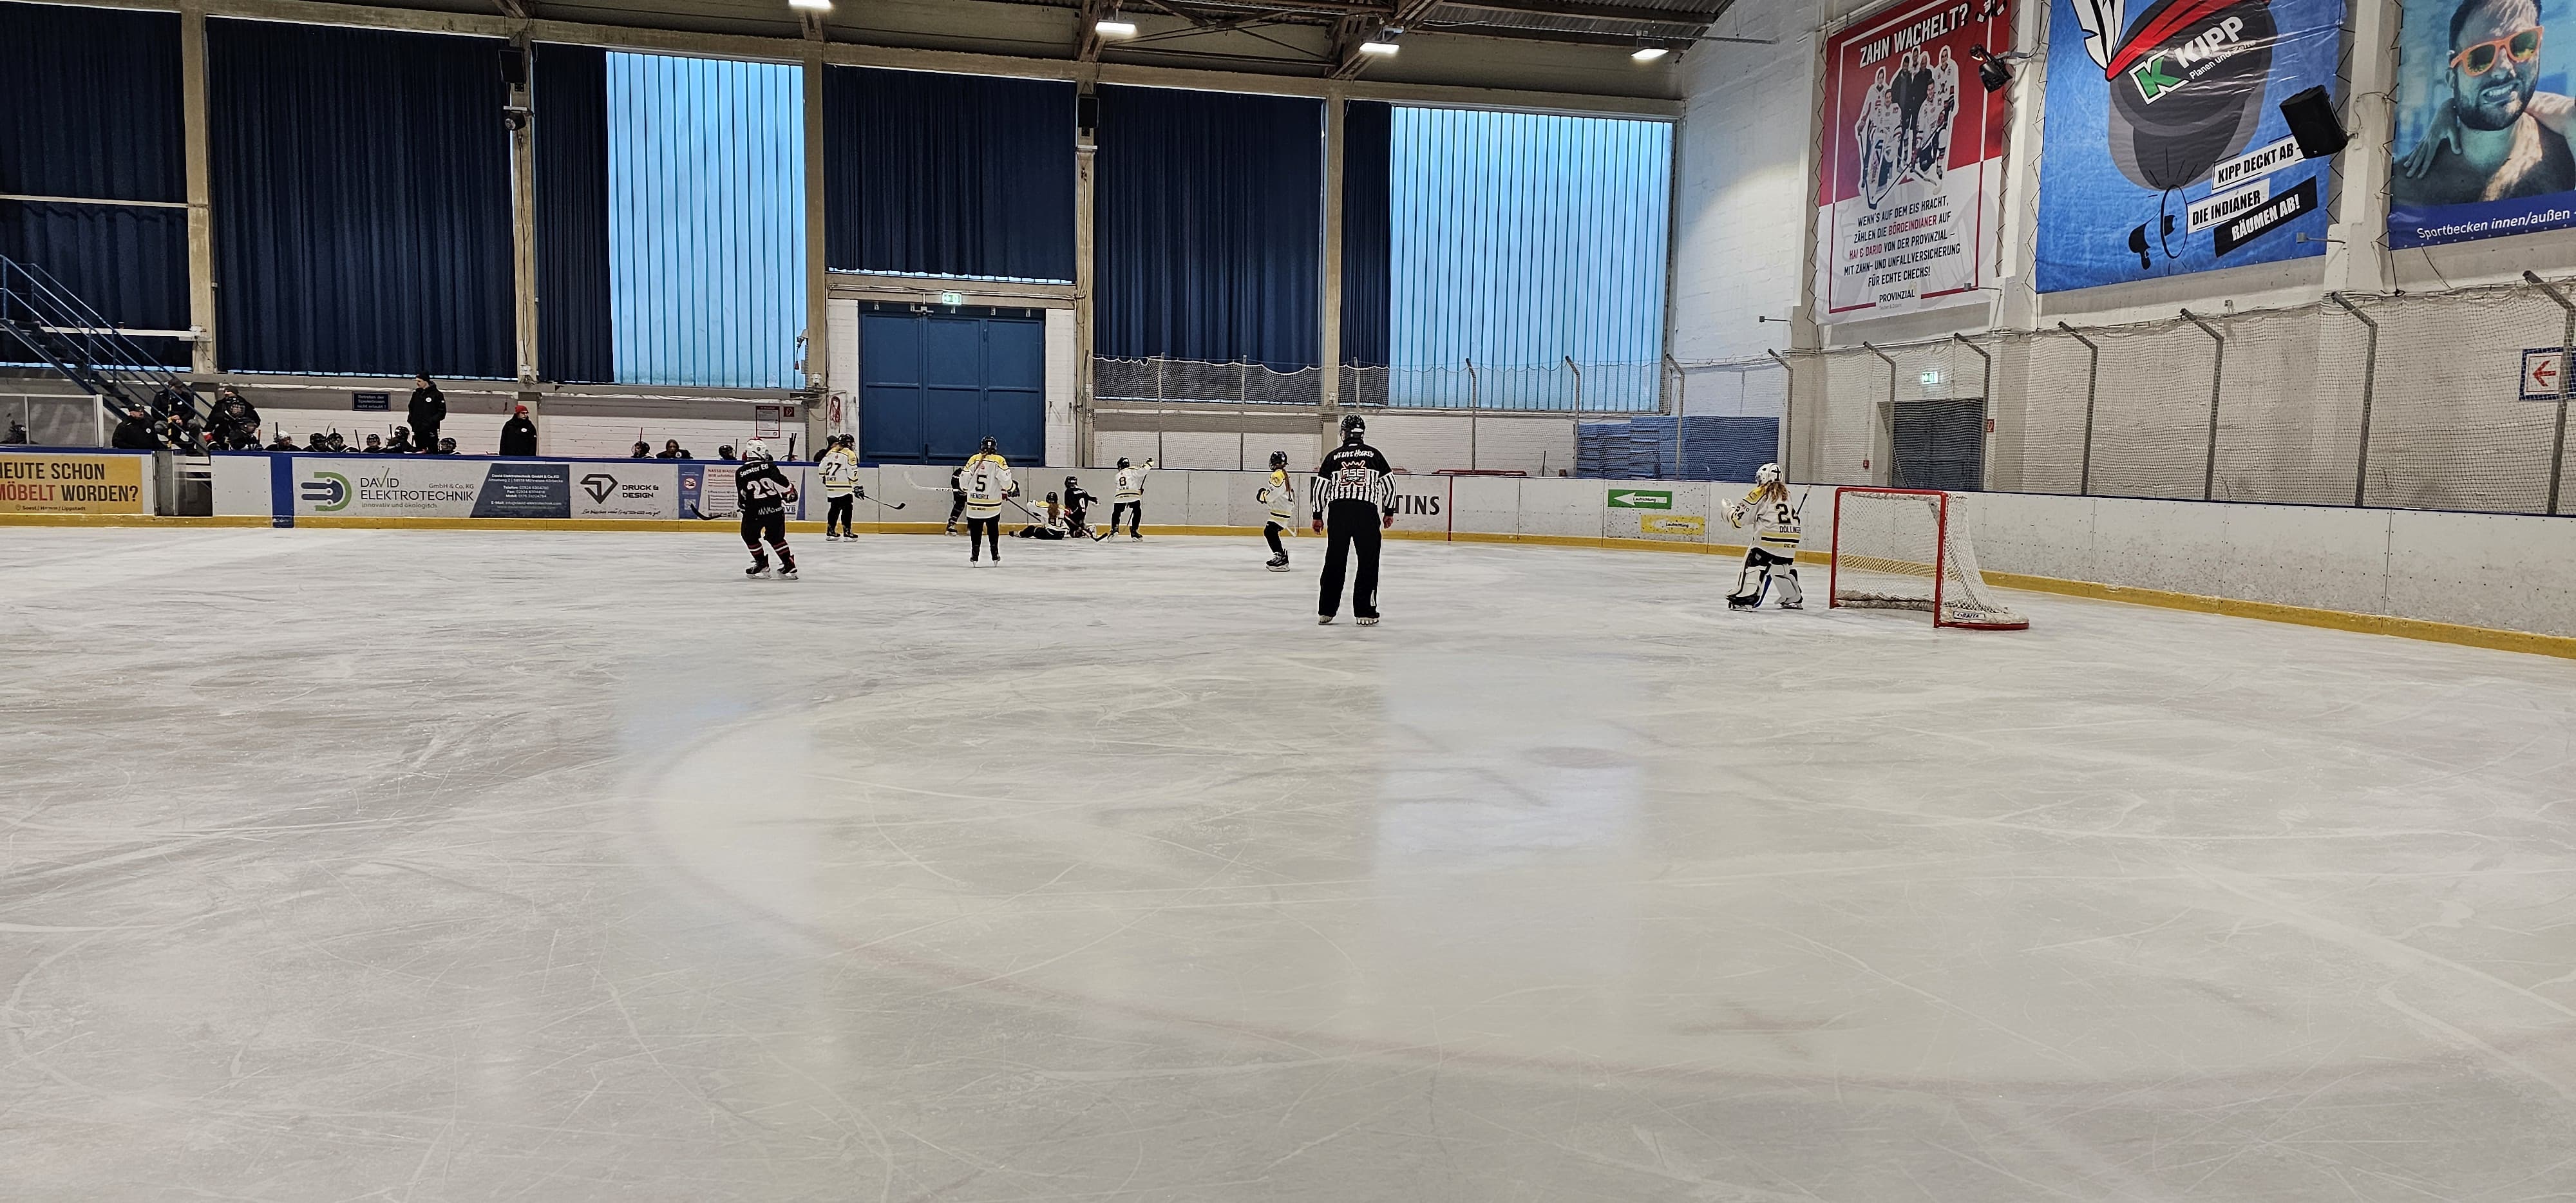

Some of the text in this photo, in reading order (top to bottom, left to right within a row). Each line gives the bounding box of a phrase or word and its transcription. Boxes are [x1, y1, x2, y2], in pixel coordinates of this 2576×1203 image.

[1860, 3, 1969, 69] ZAHN WACKELT?
[2174, 15, 2244, 69] KIPP
[2189, 61, 2216, 80] Planen
[2214, 50, 2232, 64] und
[2217, 142, 2295, 184] KIPP DECKT AB
[1880, 209, 1893, 222] AUF
[1894, 206, 1908, 218] DEM
[1909, 203, 1920, 214] EIS
[2192, 189, 2261, 226] DIE INDIANER
[2231, 193, 2301, 242] RÄUMEN AB!
[1853, 211, 1952, 244] ZÄHLEN DIE BÖRDEINDIANER AUF
[2416, 209, 2570, 240] Sportbecken innen/außen
[1865, 243, 1882, 257] DARIO
[1884, 240, 1896, 253] VON
[1897, 237, 1910, 250] DER
[1911, 229, 1948, 247] PROVINZIAL
[1844, 243, 1961, 276] MIT ZAHN- UND UNFALLVERSICHERUNG
[1868, 274, 1880, 287] FÜR
[1882, 270, 1902, 284] ECHTE
[1879, 289, 1915, 303] PROVINZIAL
[51, 462, 105, 480] SCHON
[360, 468, 399, 488] DAVID
[825, 462, 841, 476] 27
[747, 477, 777, 499] 29
[975, 474, 987, 492] 5
[1119, 477, 1126, 486] 8
[61, 484, 138, 502] WORDEN?
[361, 490, 474, 501] ELEKTROTECHNIK
[1079, 497, 1086, 512] 9
[1381, 495, 1440, 515] TINS
